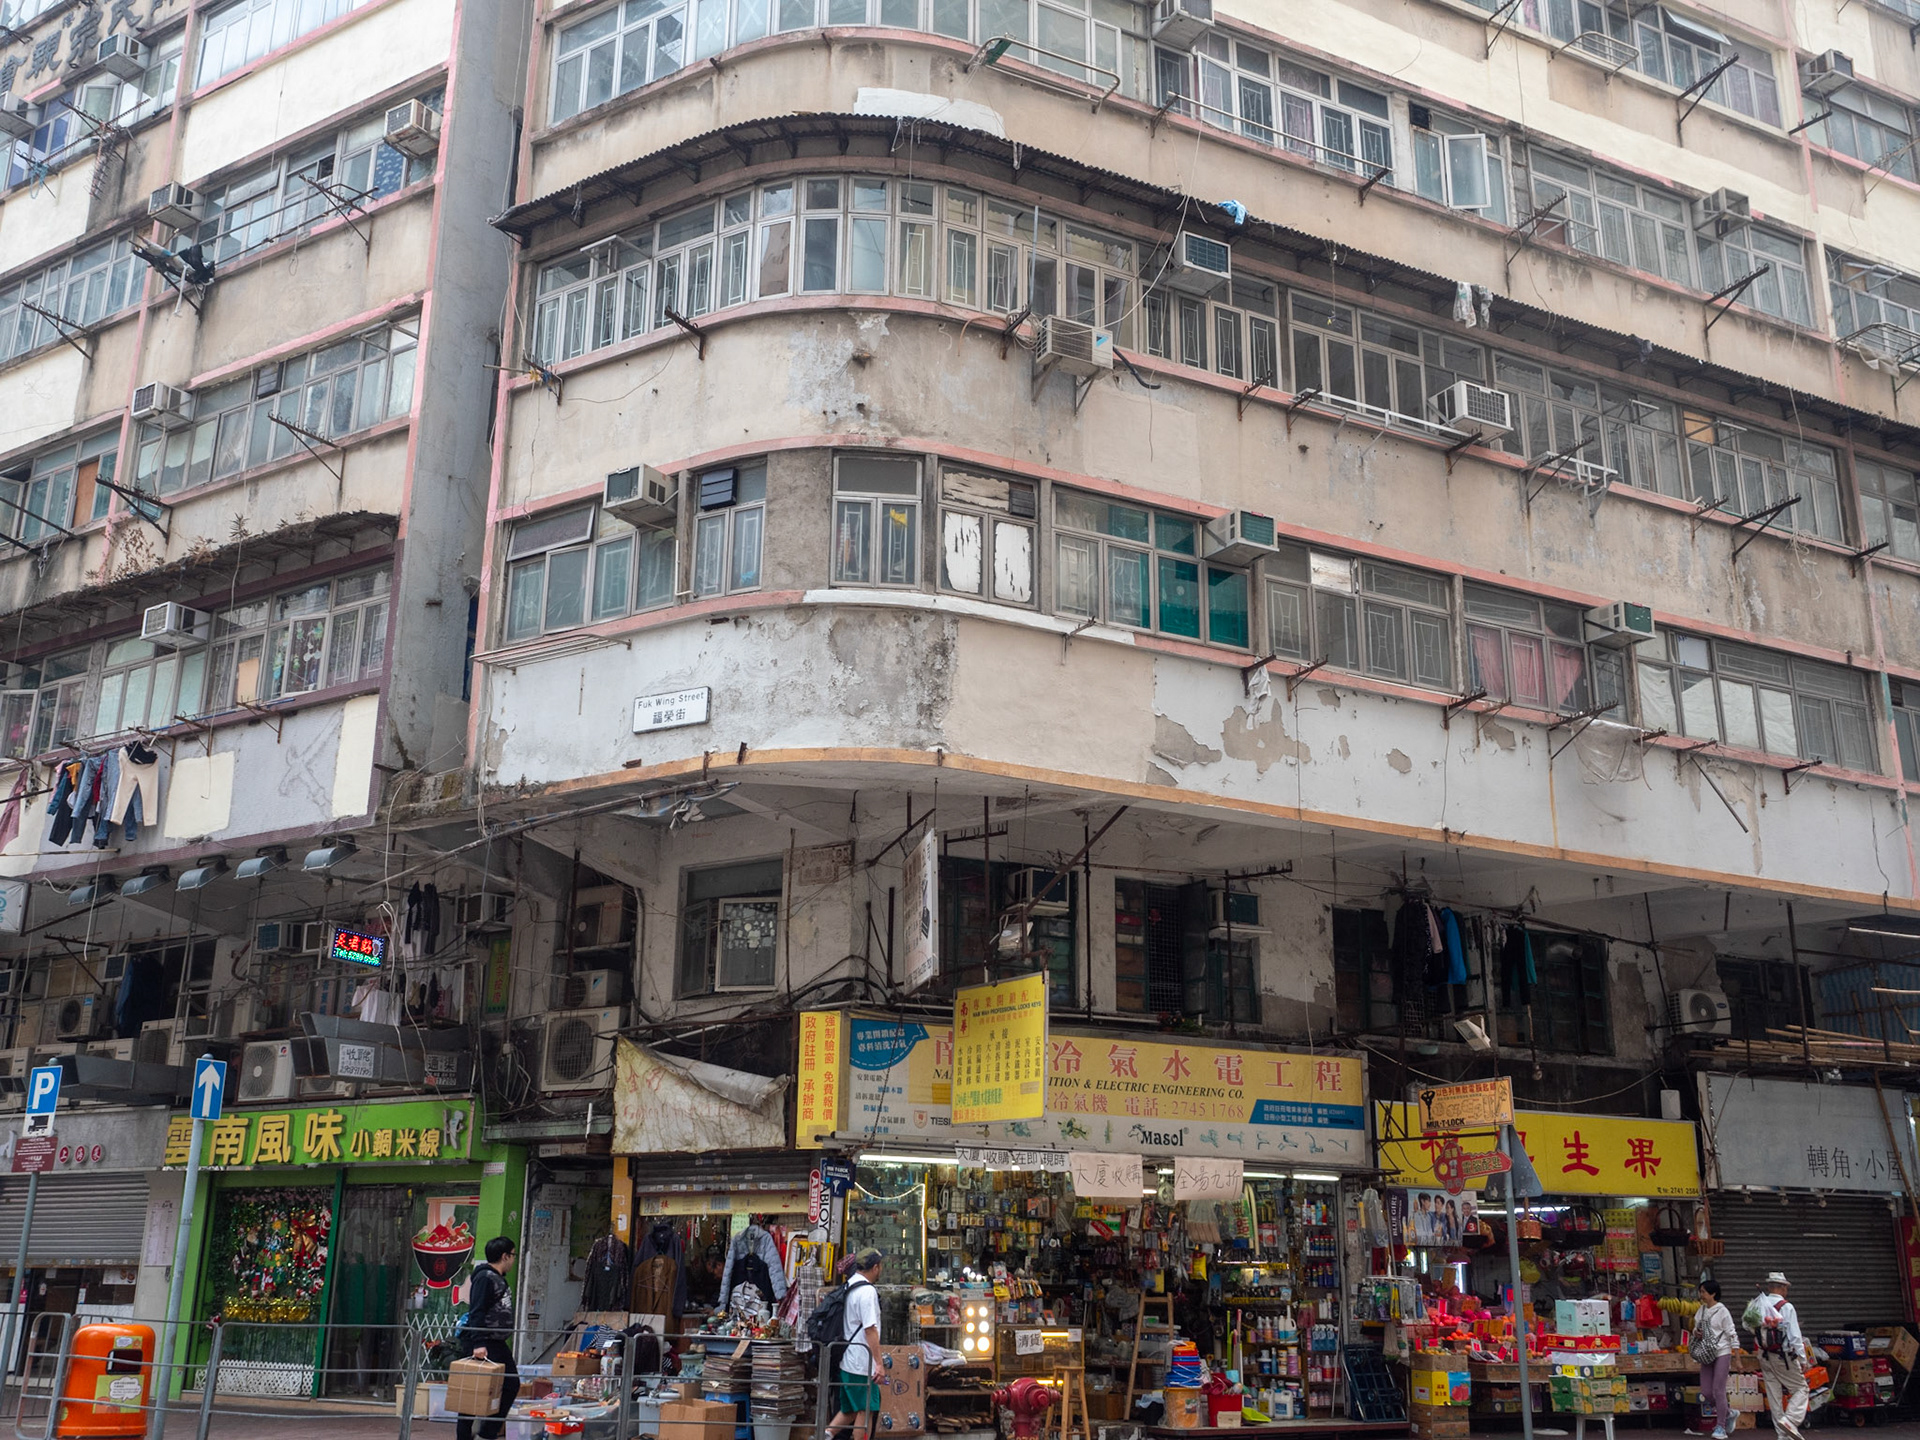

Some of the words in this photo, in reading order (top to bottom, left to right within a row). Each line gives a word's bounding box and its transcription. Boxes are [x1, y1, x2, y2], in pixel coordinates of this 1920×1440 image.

[638, 700, 652, 709] Fuk
[656, 697, 675, 706] Wing
[678, 692, 704, 702] Street
[652, 708, 686, 724] 福榮街
[32, 1072, 55, 1110] P
[1084, 1079, 1092, 1090] &
[1096, 1080, 1149, 1093] ELECTRIC
[1152, 1084, 1225, 1098] ENGINEERING
[1228, 1088, 1244, 1100] CO.
[1171, 1100, 1206, 1117] 2745
[1211, 1103, 1244, 1119] 1768
[164, 1108, 344, 1166] 雲南風味
[350, 1128, 440, 1158] 小鍋米線
[1140, 1128, 1184, 1147] Masol
[1176, 1166, 1241, 1198] 全場九折
[810, 1177, 819, 1217] ABUS
[818, 1182, 830, 1230] ABLOY
